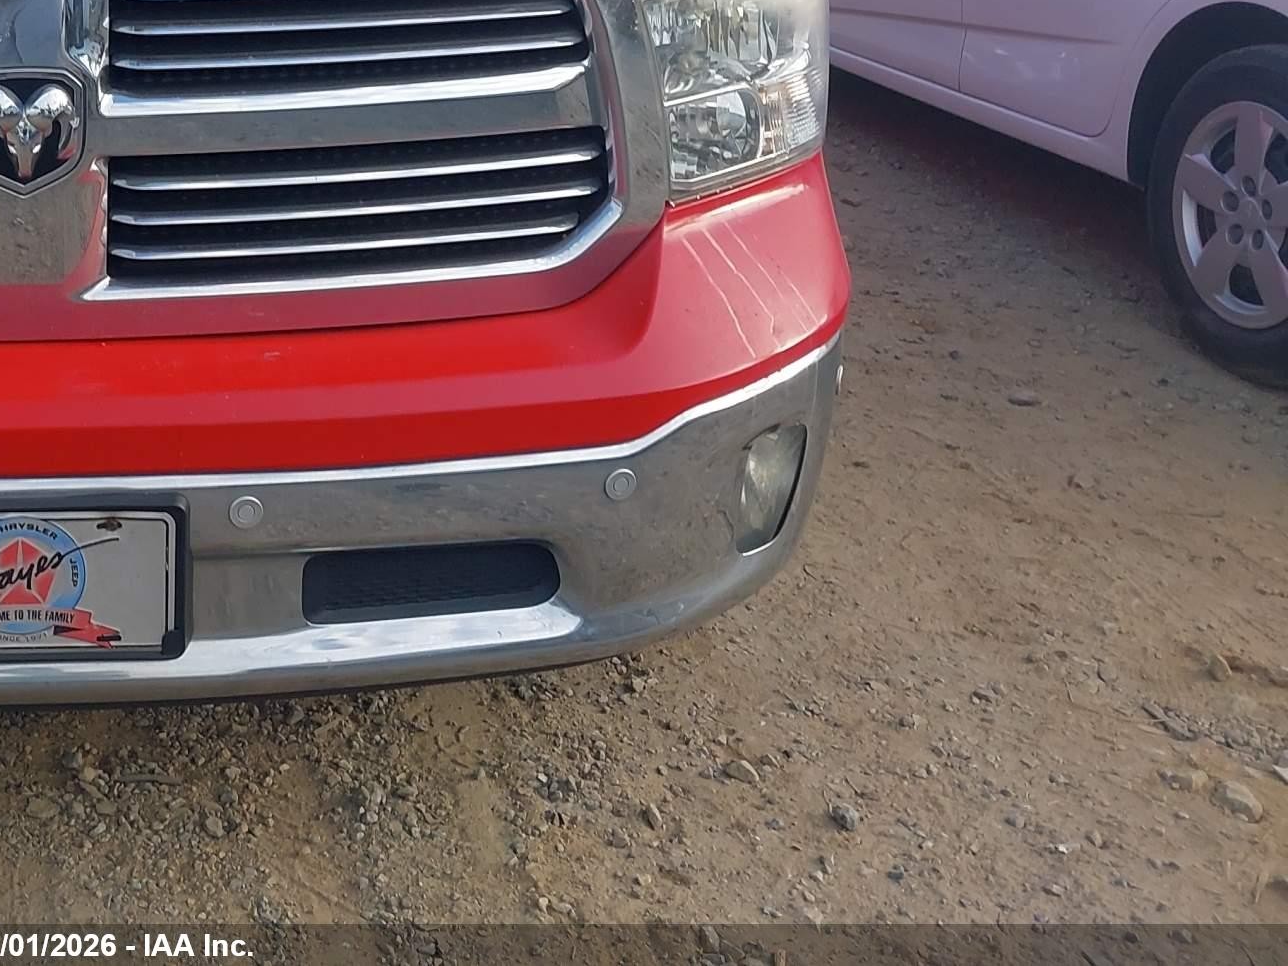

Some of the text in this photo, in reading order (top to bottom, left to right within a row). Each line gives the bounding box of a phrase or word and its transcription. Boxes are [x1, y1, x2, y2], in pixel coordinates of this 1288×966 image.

[70, 557, 79, 588] JEEP
[14, 609, 24, 620] TO
[27, 609, 42, 621] THE
[45, 611, 76, 624] FAMILY
